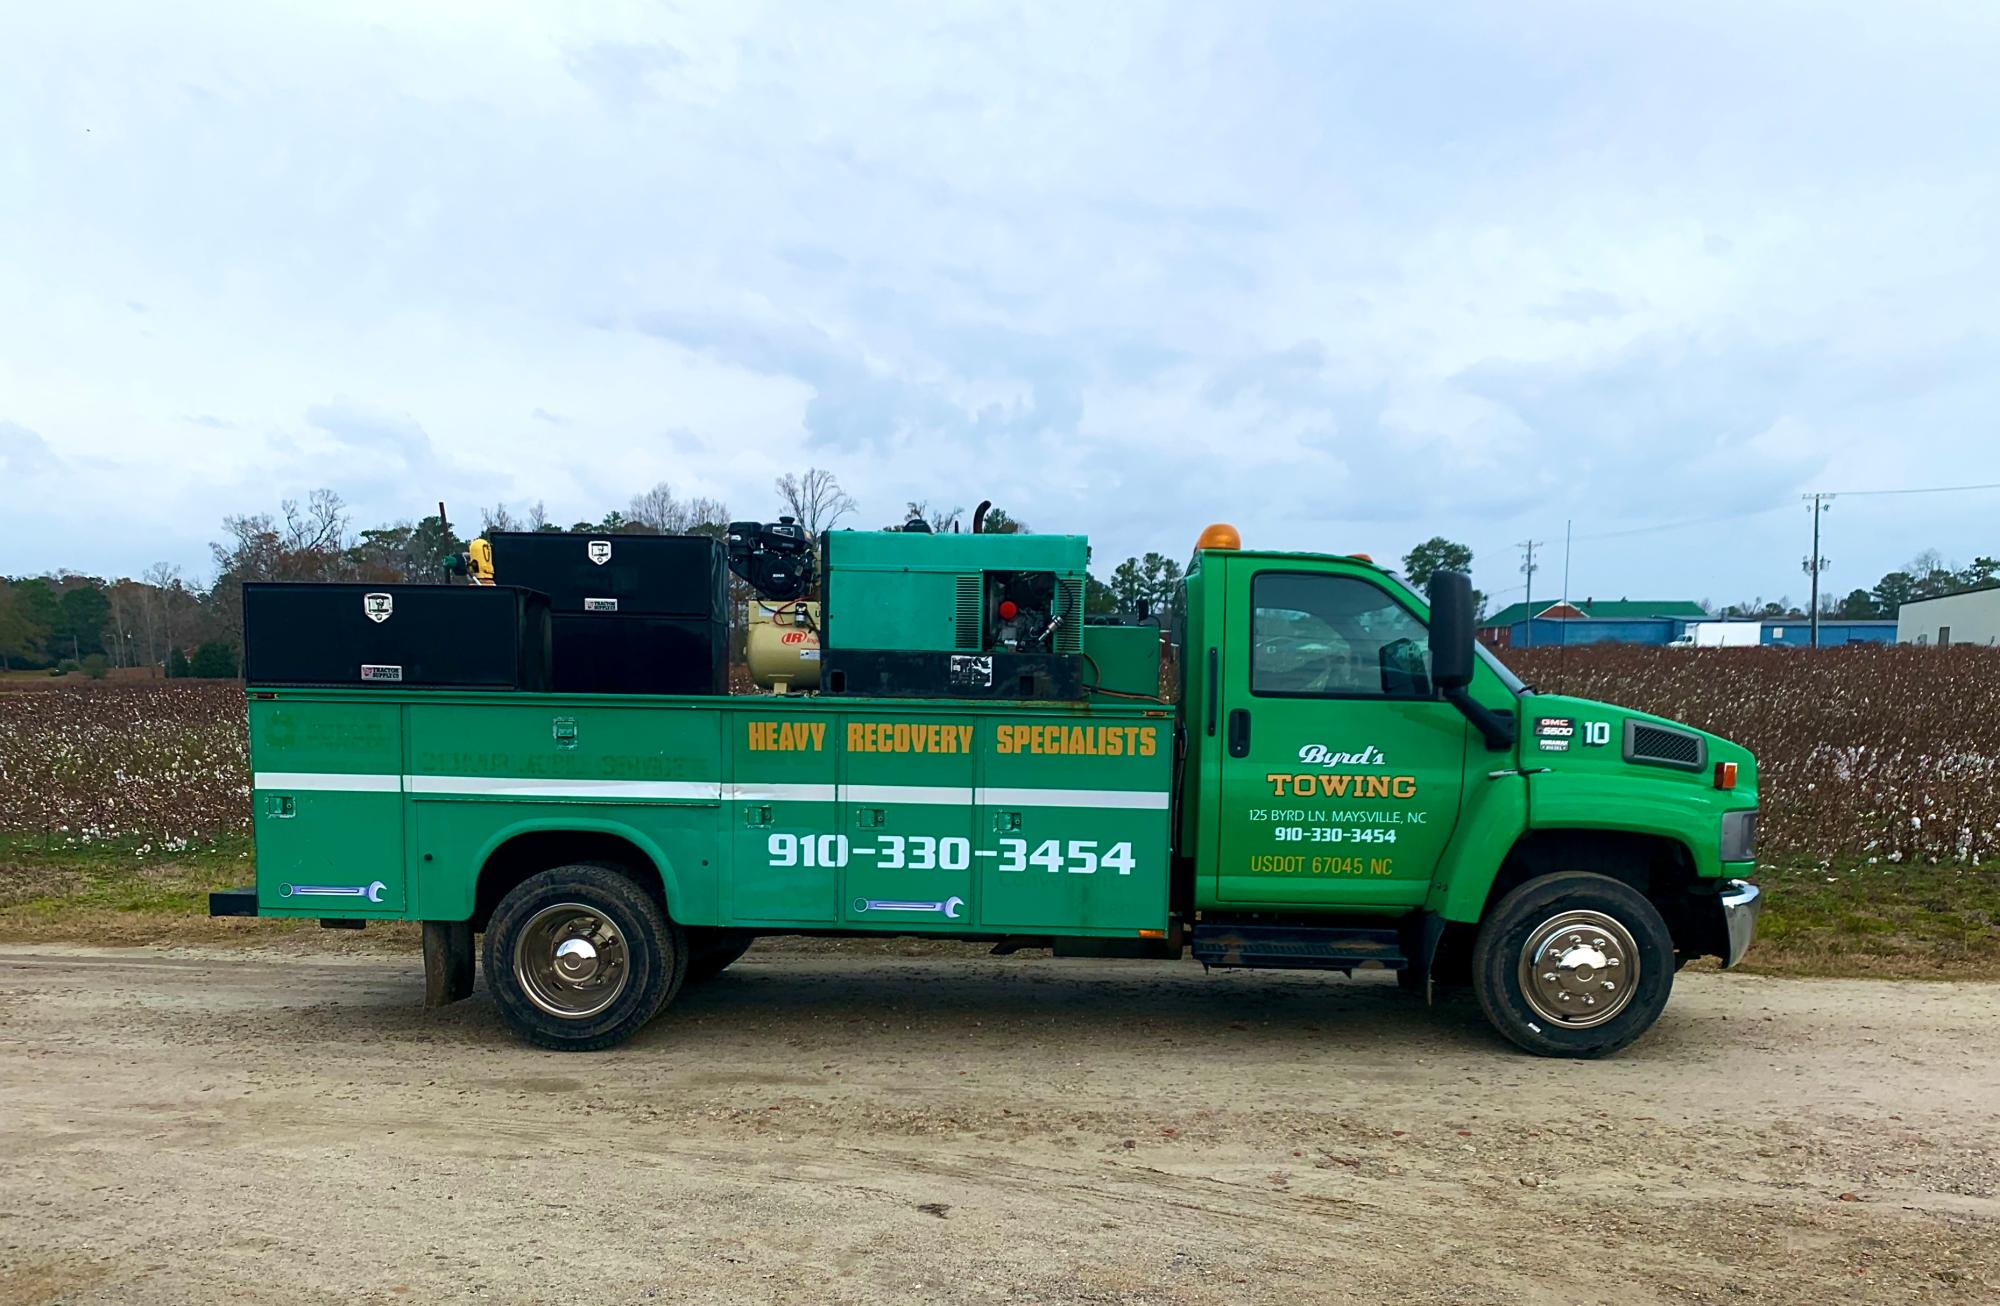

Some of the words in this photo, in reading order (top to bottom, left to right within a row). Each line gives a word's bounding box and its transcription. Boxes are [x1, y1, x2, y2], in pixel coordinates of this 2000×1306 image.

[1541, 718, 1569, 726] GMC
[1584, 721, 1610, 744] 10
[748, 722, 826, 751] HEAVY
[847, 723, 974, 753] RECOVERY
[997, 725, 1157, 756] SPECIALISTS
[1299, 744, 1386, 768] Byrd's
[1267, 774, 1417, 798] TOWING
[1249, 809, 1268, 821] 125
[1271, 810, 1305, 822] BYRD
[1308, 811, 1328, 822] LN.
[1331, 811, 1403, 825] MAYSVILLE,
[1407, 812, 1428, 824] NC
[1274, 827, 1397, 843] 910-330-3454
[768, 833, 1136, 875] 910-330-3454
[1251, 856, 1306, 873] USDOT
[1312, 857, 1363, 874] 67045
[1370, 858, 1393, 875] NC
